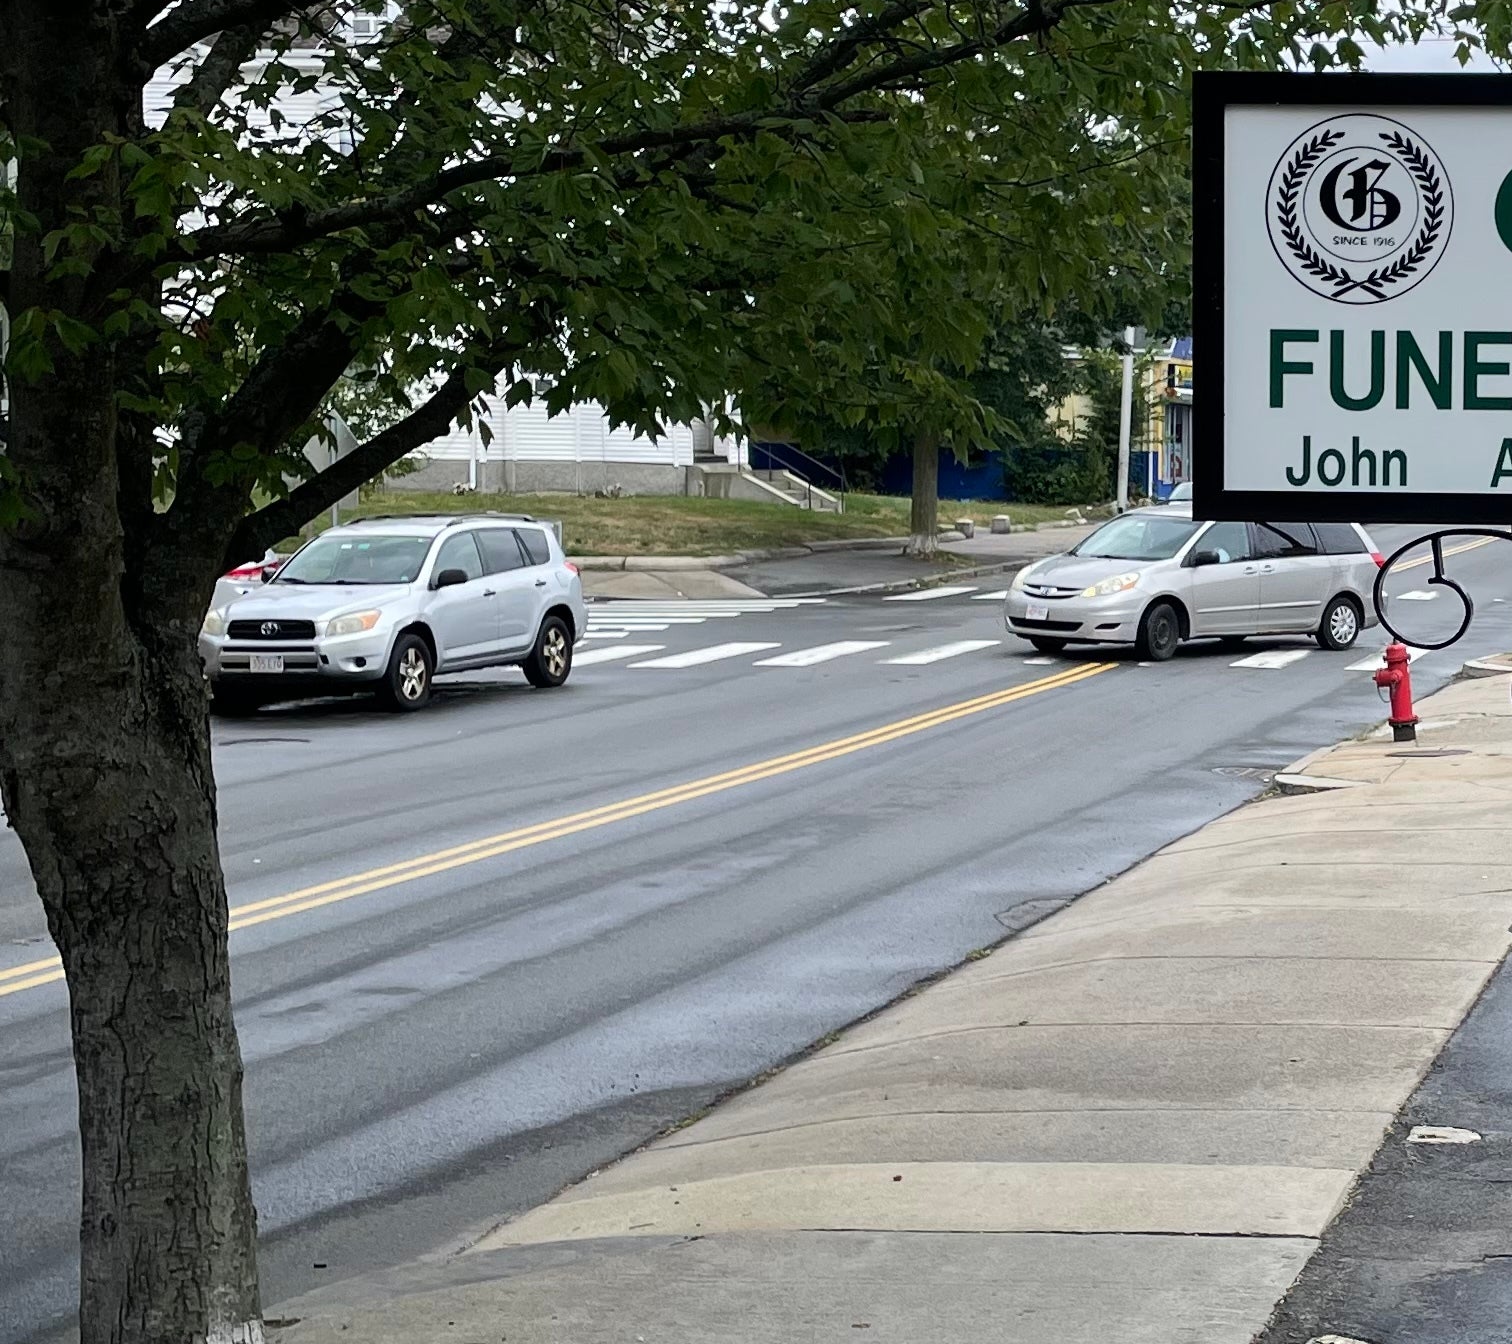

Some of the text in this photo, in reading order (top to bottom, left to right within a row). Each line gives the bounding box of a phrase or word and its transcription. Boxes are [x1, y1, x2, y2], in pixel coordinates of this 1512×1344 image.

[1332, 236, 1395, 247] SINCE 1916
[1286, 436, 1407, 487] John
